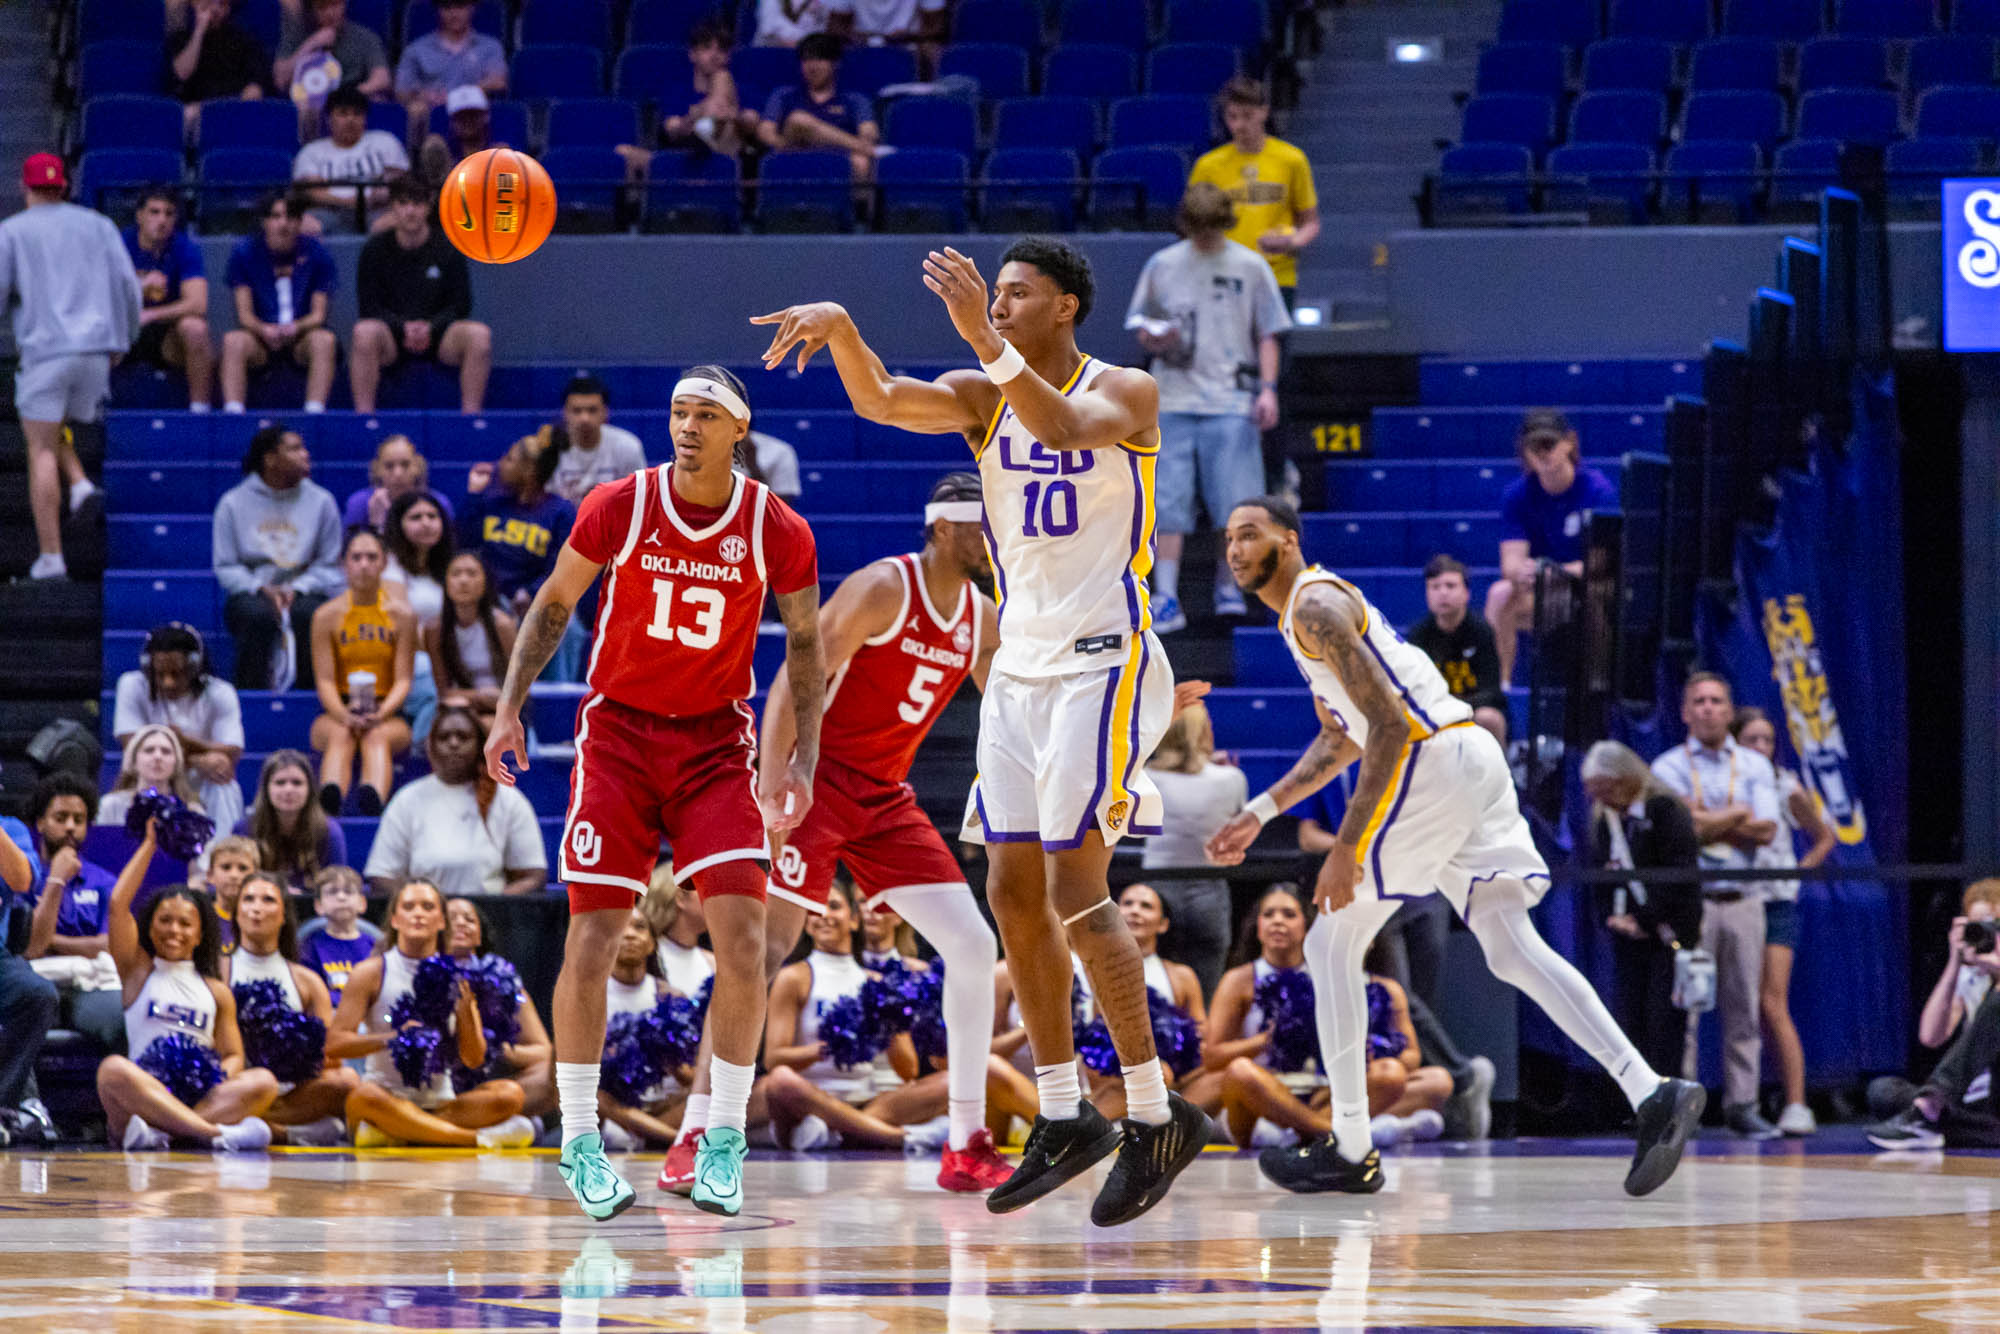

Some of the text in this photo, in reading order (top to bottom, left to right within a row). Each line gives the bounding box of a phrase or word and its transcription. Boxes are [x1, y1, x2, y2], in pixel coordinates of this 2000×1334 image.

[1312, 424, 1360, 451] 121
[1022, 480, 1079, 537] 10
[483, 516, 551, 557] LSU
[720, 537, 745, 561] SEC
[641, 553, 742, 583] OKLAHOMA
[647, 578, 726, 650] 13
[898, 664, 944, 725] 5
[572, 821, 602, 866] OU
[148, 1001, 208, 1030] LSU
